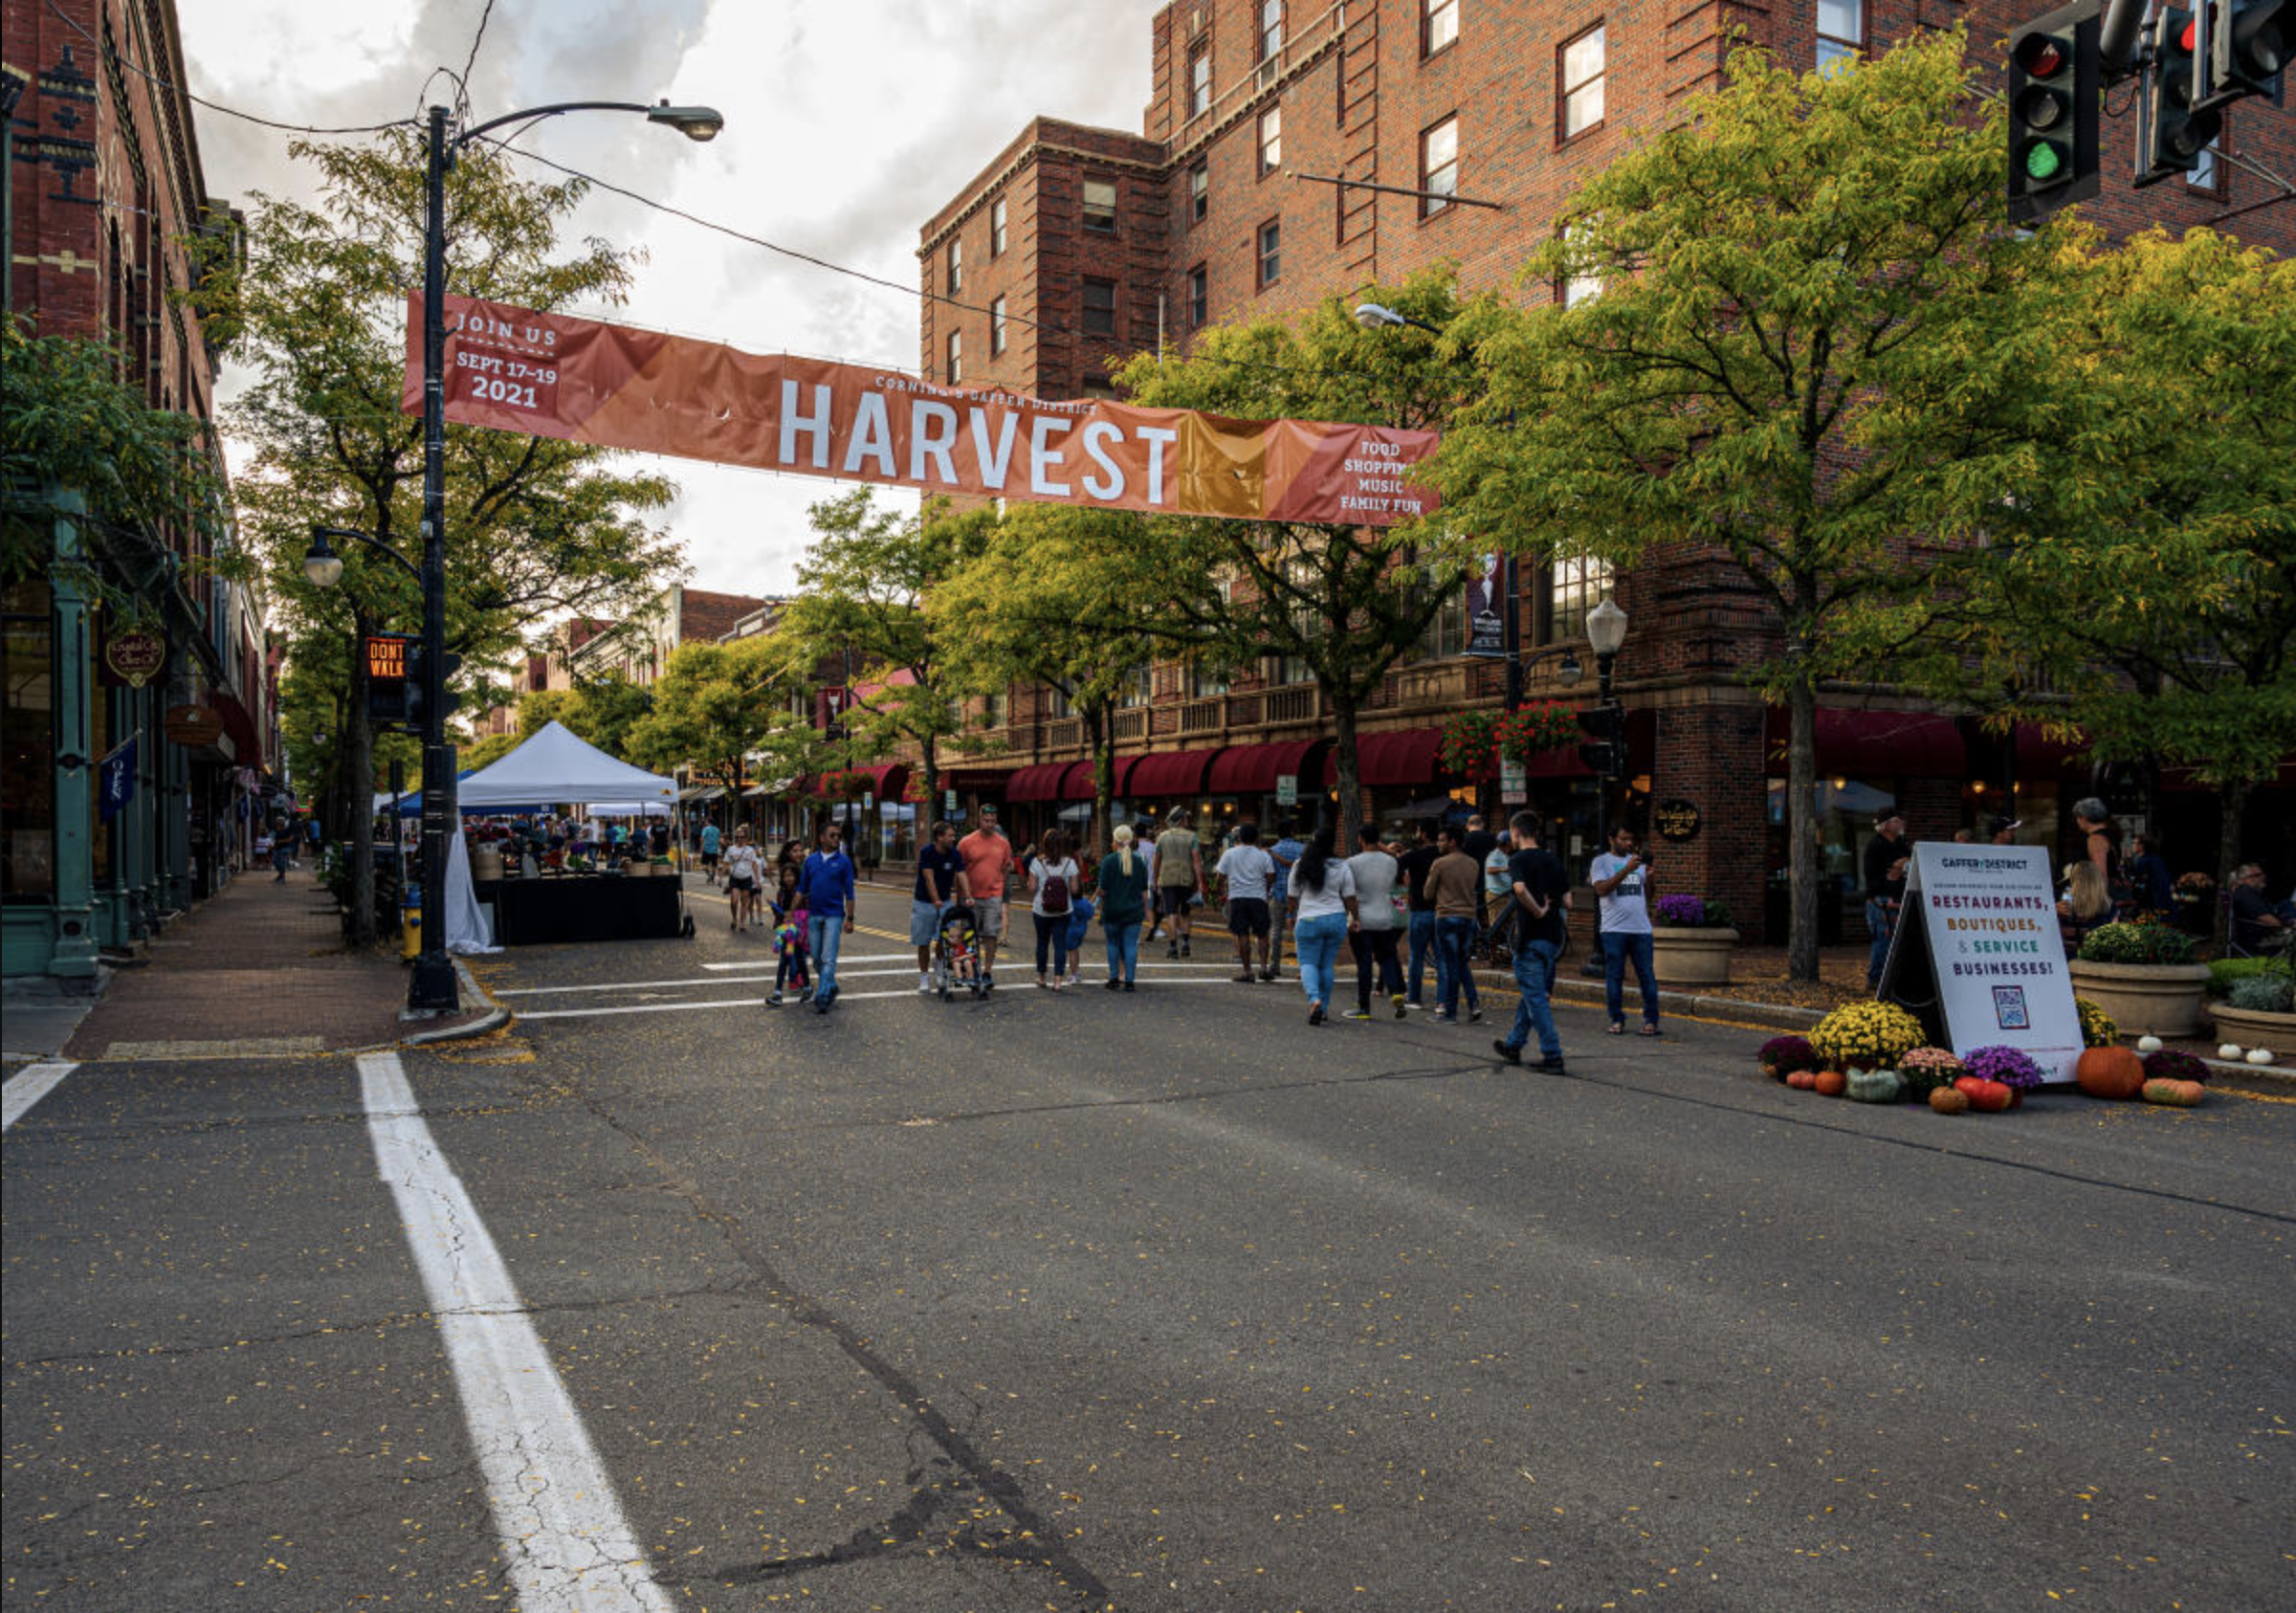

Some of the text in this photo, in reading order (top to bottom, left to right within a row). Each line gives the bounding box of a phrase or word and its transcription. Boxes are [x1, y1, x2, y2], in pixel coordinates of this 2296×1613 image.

[456, 314, 556, 345] JOIN US
[457, 351, 504, 374] SEPT
[472, 375, 538, 409] 2021
[779, 379, 1178, 504] HARVEST
[1361, 441, 1401, 456] FOOD
[1344, 458, 1414, 475] SHOPPIN
[1358, 478, 1403, 495] MUSIC
[1340, 497, 1423, 515] FAMILY FUN
[370, 642, 403, 659] DONT
[370, 659, 405, 676] WALK
[1941, 857, 2027, 871] GAFFER DISTRICT
[1932, 895, 2048, 912] RESTAURANTS,
[1958, 939, 2040, 954] & SERVICE
[1953, 961, 2053, 977] BUSINESSES!
